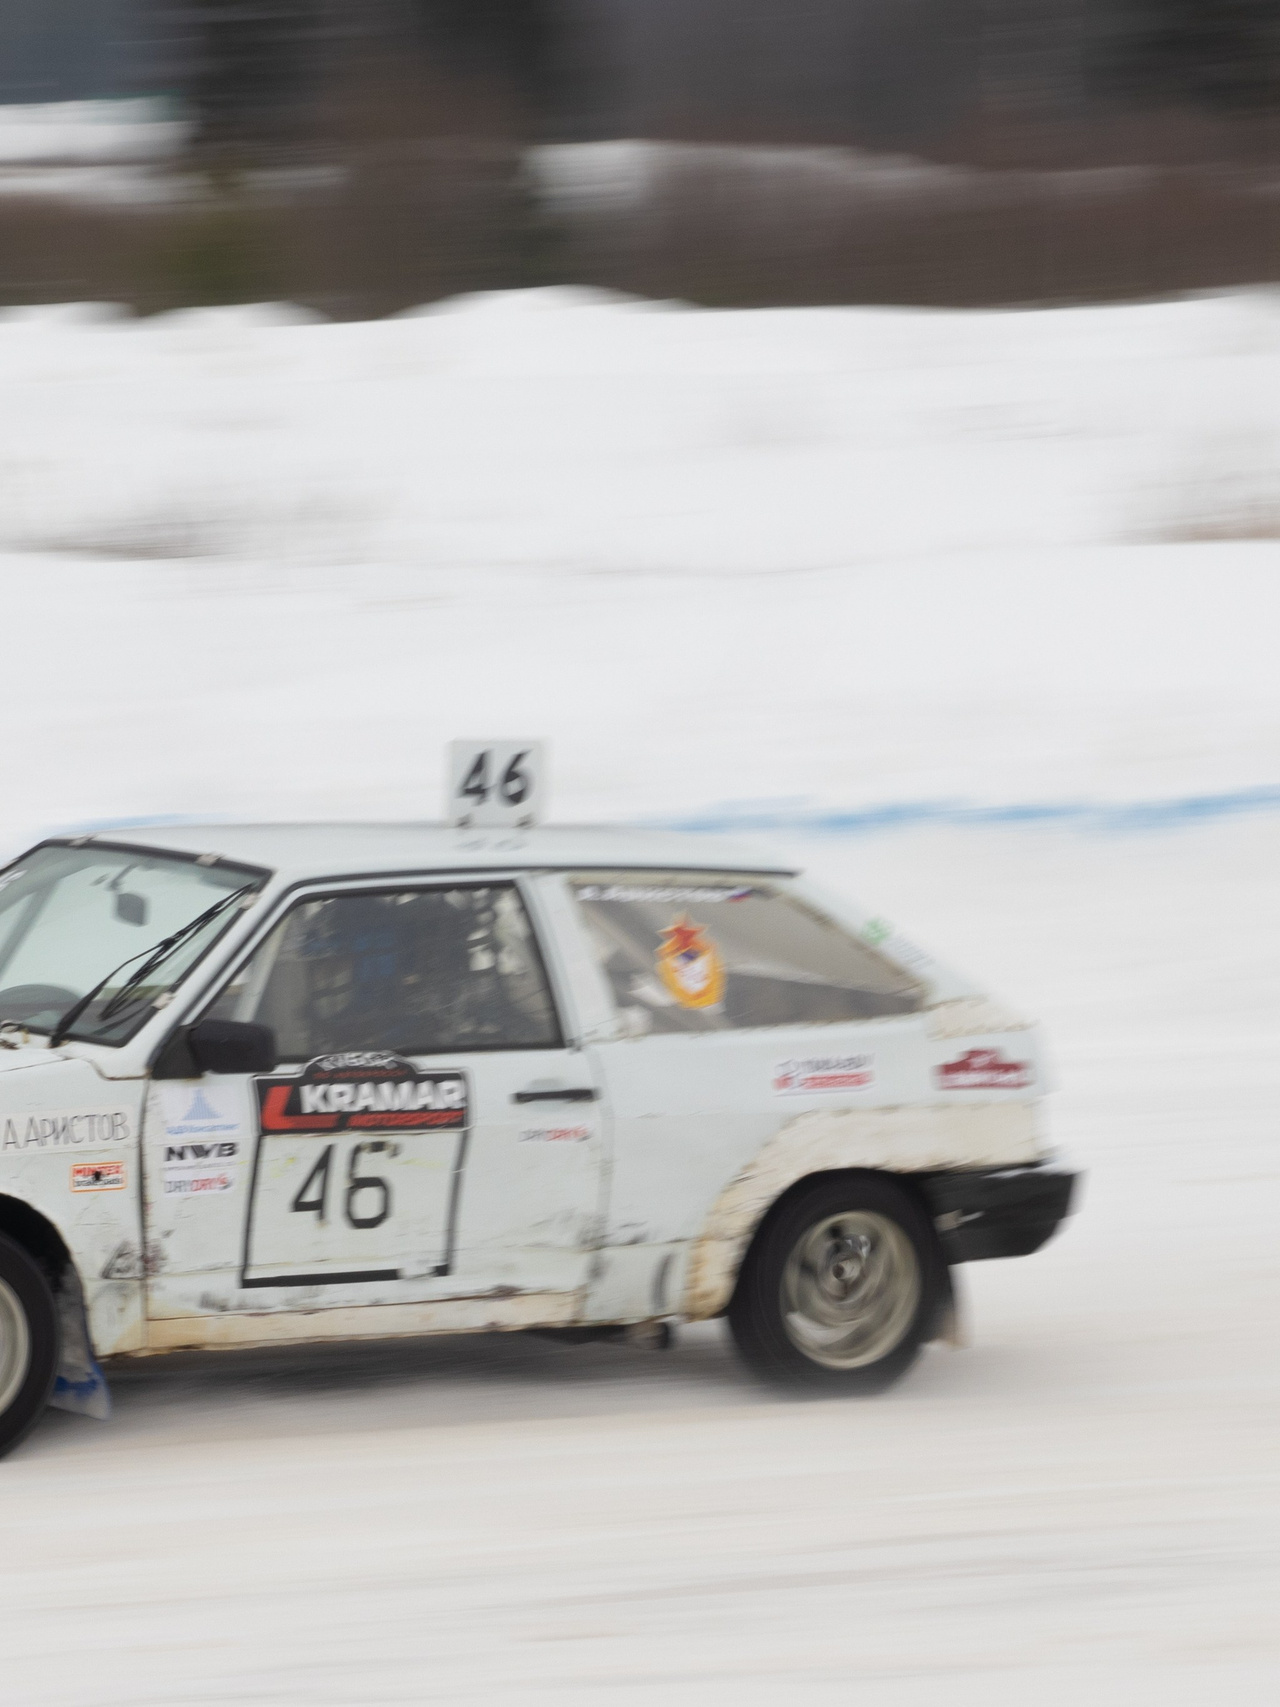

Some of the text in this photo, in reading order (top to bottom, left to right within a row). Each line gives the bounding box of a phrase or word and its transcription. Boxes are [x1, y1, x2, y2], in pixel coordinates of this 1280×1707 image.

[457, 748, 532, 808] 46
[298, 1079, 470, 1114] KRAMAR
[164, 1142, 239, 1162] NWB
[291, 1141, 401, 1230] 46
